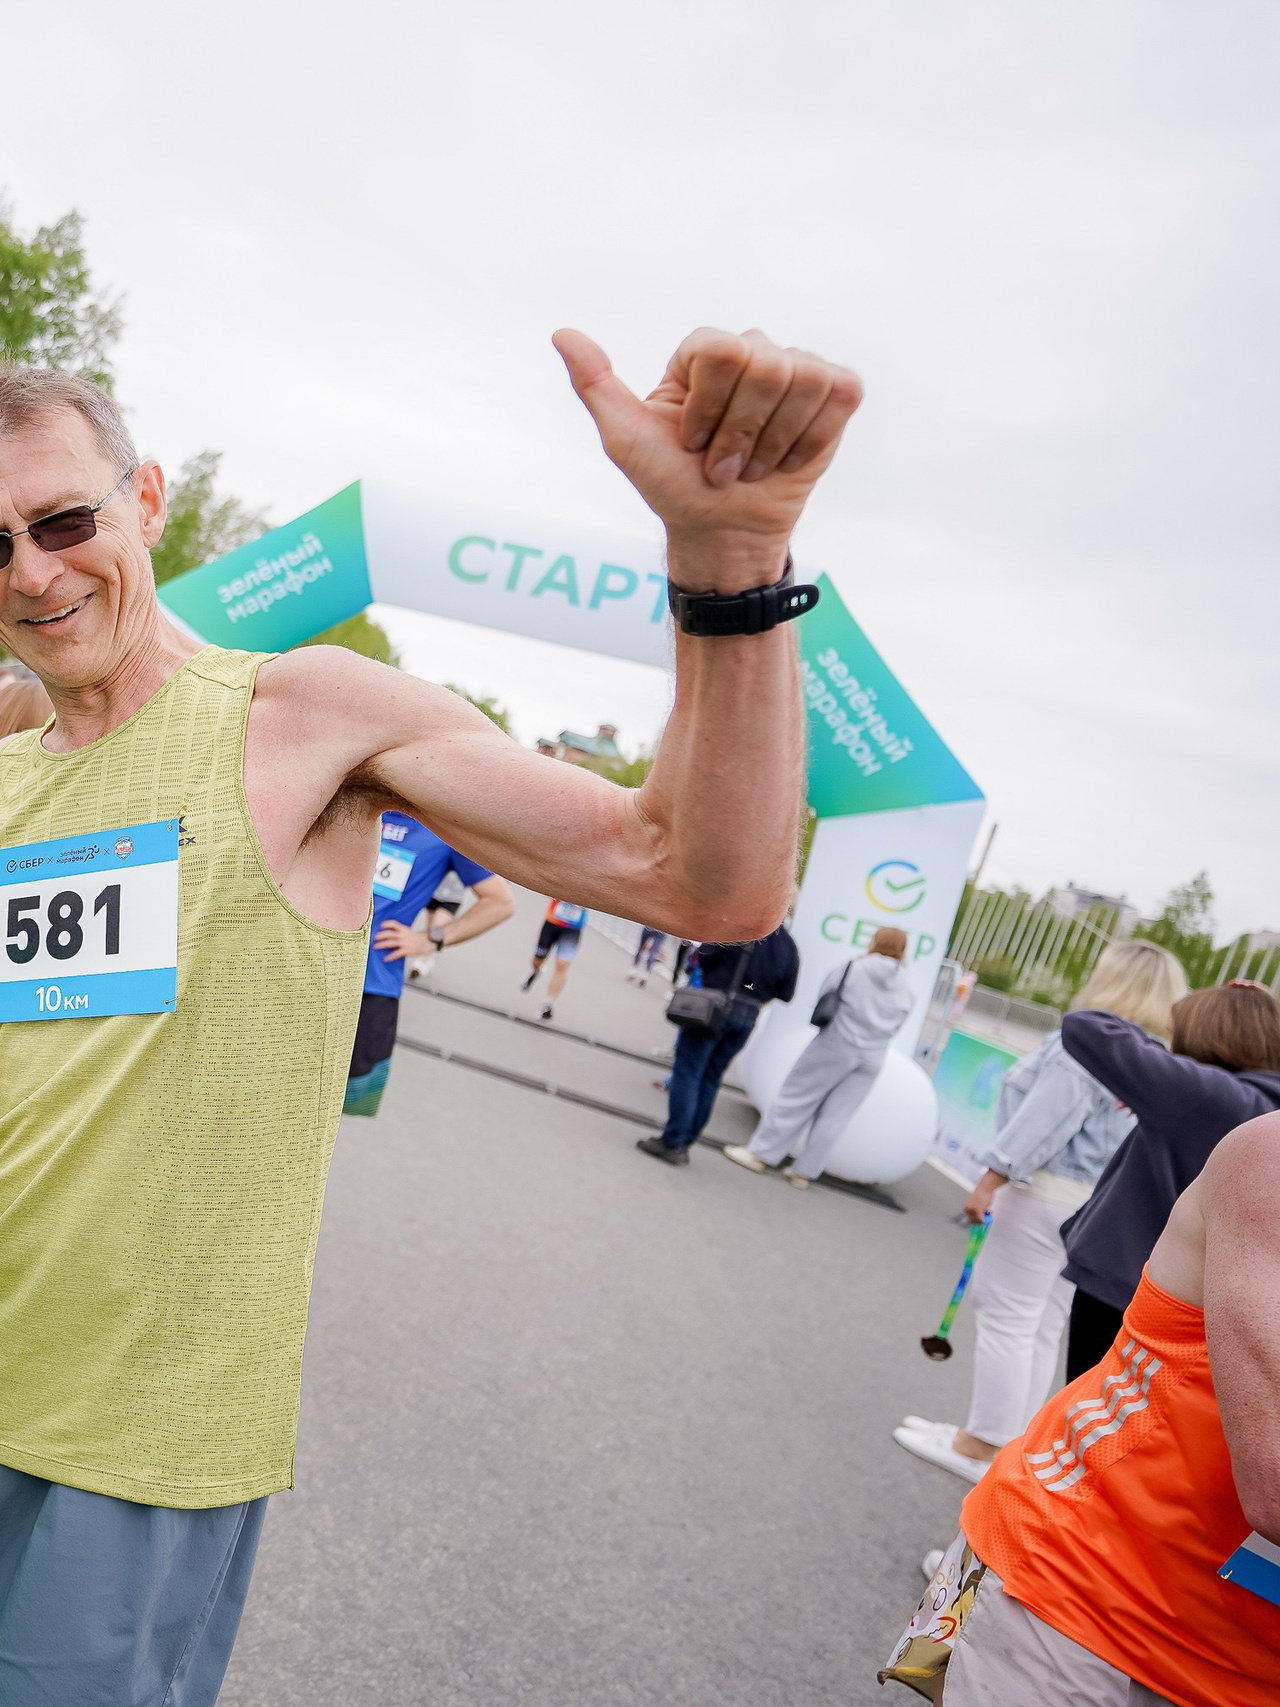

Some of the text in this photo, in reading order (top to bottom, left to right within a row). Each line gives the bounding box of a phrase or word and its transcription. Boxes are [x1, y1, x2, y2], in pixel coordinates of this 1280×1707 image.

[216, 532, 324, 604] зелёный
[226, 557, 333, 624] марафон
[816, 647, 914, 763] зелёный
[19, 857, 44, 869] СБЕР
[380, 863, 390, 878] 6
[5, 884, 122, 965] 581
